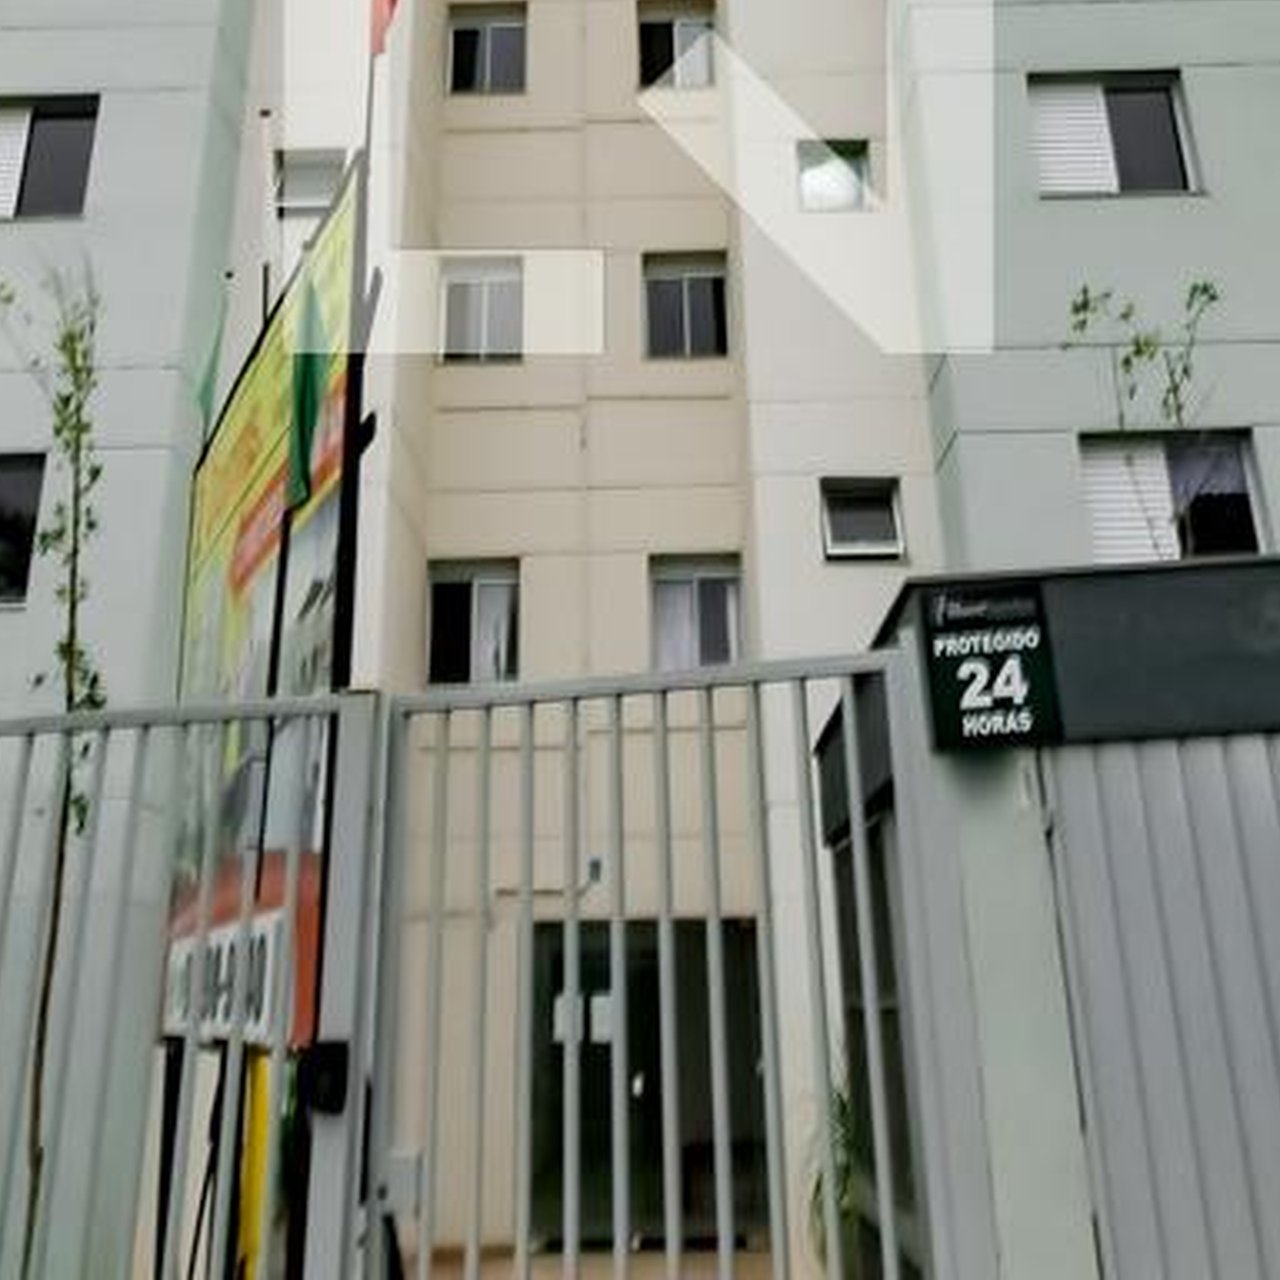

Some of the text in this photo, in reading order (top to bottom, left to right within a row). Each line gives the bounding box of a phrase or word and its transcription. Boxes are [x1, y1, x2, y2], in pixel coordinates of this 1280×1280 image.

[933, 626, 1041, 657] PROTEGIDO
[956, 653, 1029, 710] 24
[962, 708, 1034, 737] HORAS
